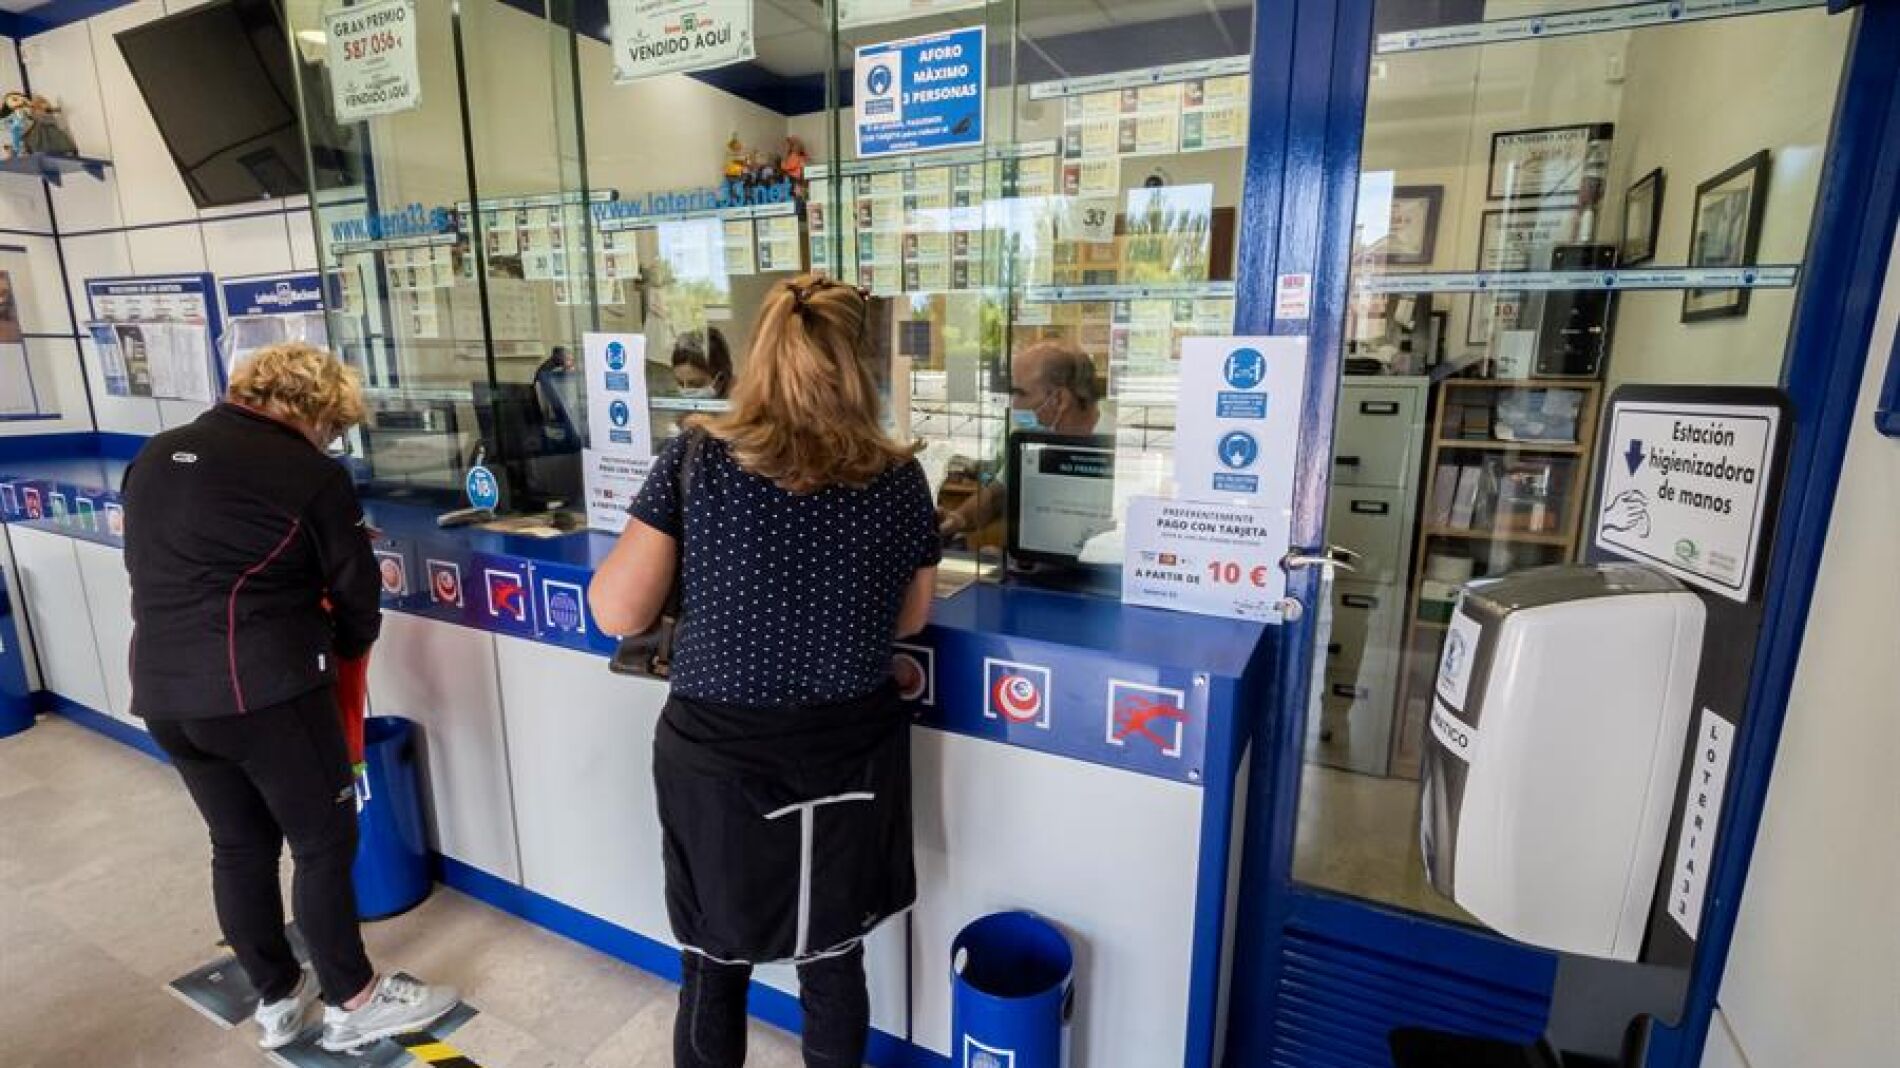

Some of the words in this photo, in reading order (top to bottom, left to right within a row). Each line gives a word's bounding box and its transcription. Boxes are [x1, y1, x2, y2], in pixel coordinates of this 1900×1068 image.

[334, 19, 364, 36] GRAN
[366, 7, 405, 28] PREMIO
[629, 36, 689, 61] VENDIDO
[919, 43, 963, 63] AFORO
[345, 90, 386, 107] VENDIDO
[912, 84, 977, 104] PERSONAS
[1671, 421, 1734, 447] Estación
[1649, 446, 1755, 484] higienizadora
[1657, 478, 1675, 501] de
[1680, 489, 1732, 514] manos
[1163, 507, 1254, 524] PREFERENTEMENTE
[1157, 518, 1188, 531] PAGO
[1190, 521, 1217, 533] CON
[1219, 523, 1268, 537] TARJETA
[1135, 569, 1143, 578] A
[1146, 570, 1183, 582] PARTIR
[1186, 574, 1200, 585] DE
[1208, 561, 1240, 585] 10
[1249, 565, 1268, 588] €
